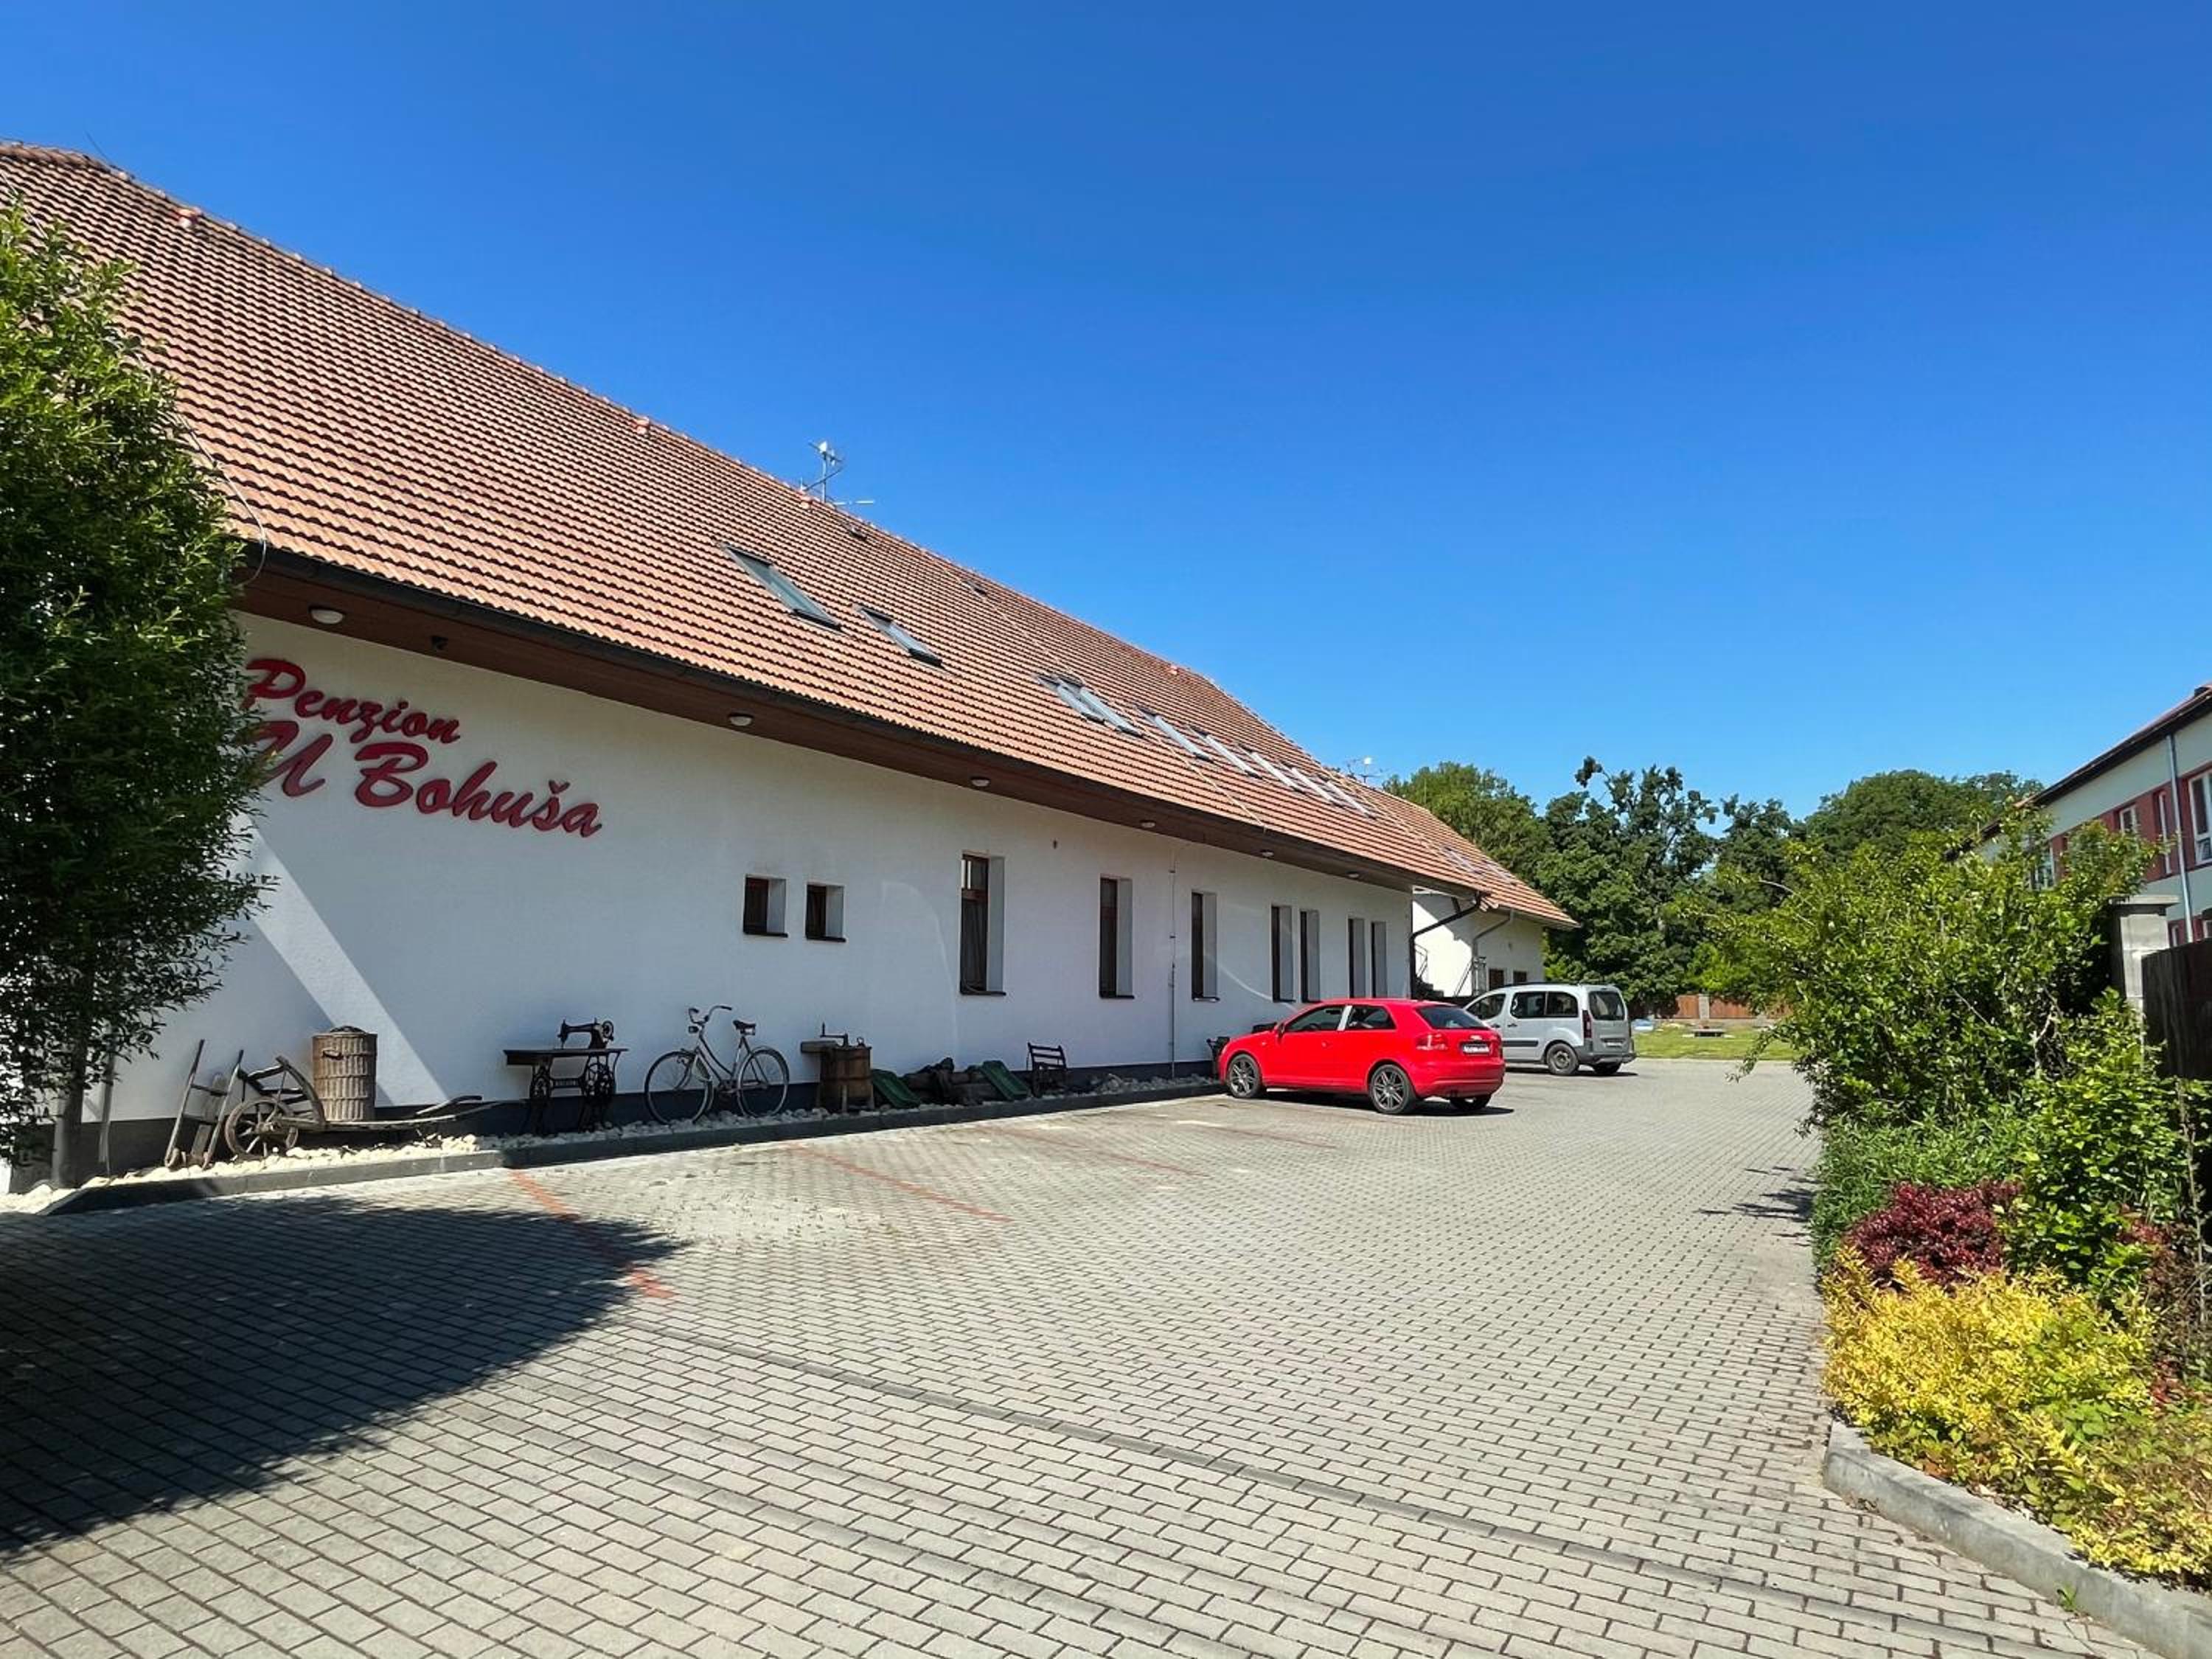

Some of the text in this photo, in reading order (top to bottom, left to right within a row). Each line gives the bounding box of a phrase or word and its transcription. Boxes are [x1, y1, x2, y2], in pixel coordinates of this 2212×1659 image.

[240, 658, 461, 744] Penzion
[243, 720, 602, 838] U Bohuša
